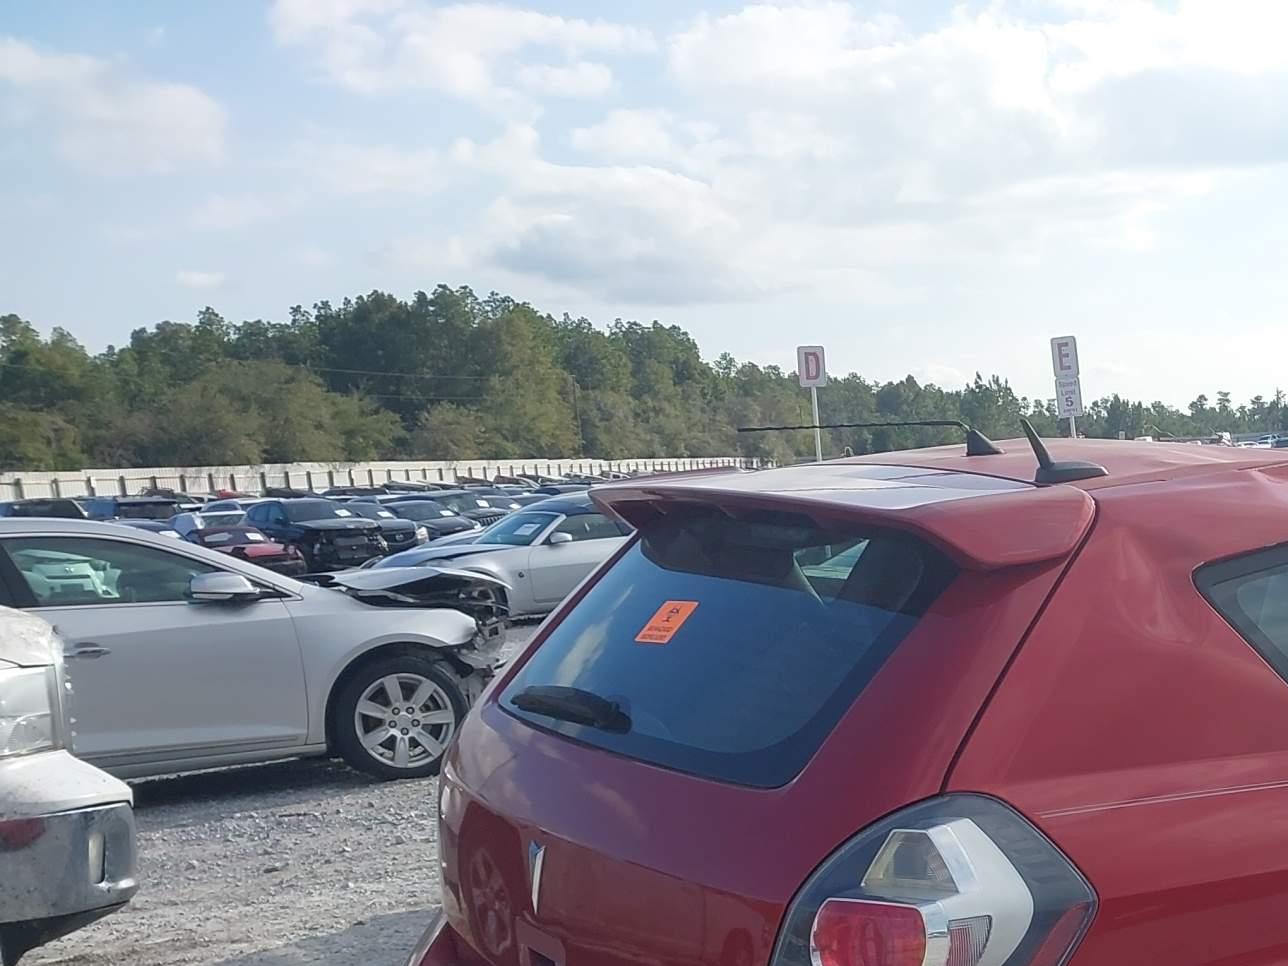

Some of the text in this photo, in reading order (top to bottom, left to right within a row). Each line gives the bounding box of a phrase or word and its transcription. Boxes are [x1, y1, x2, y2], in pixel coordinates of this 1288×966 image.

[804, 352, 821, 380] D
[1057, 342, 1072, 371] E
[1065, 396, 1074, 408] 5
